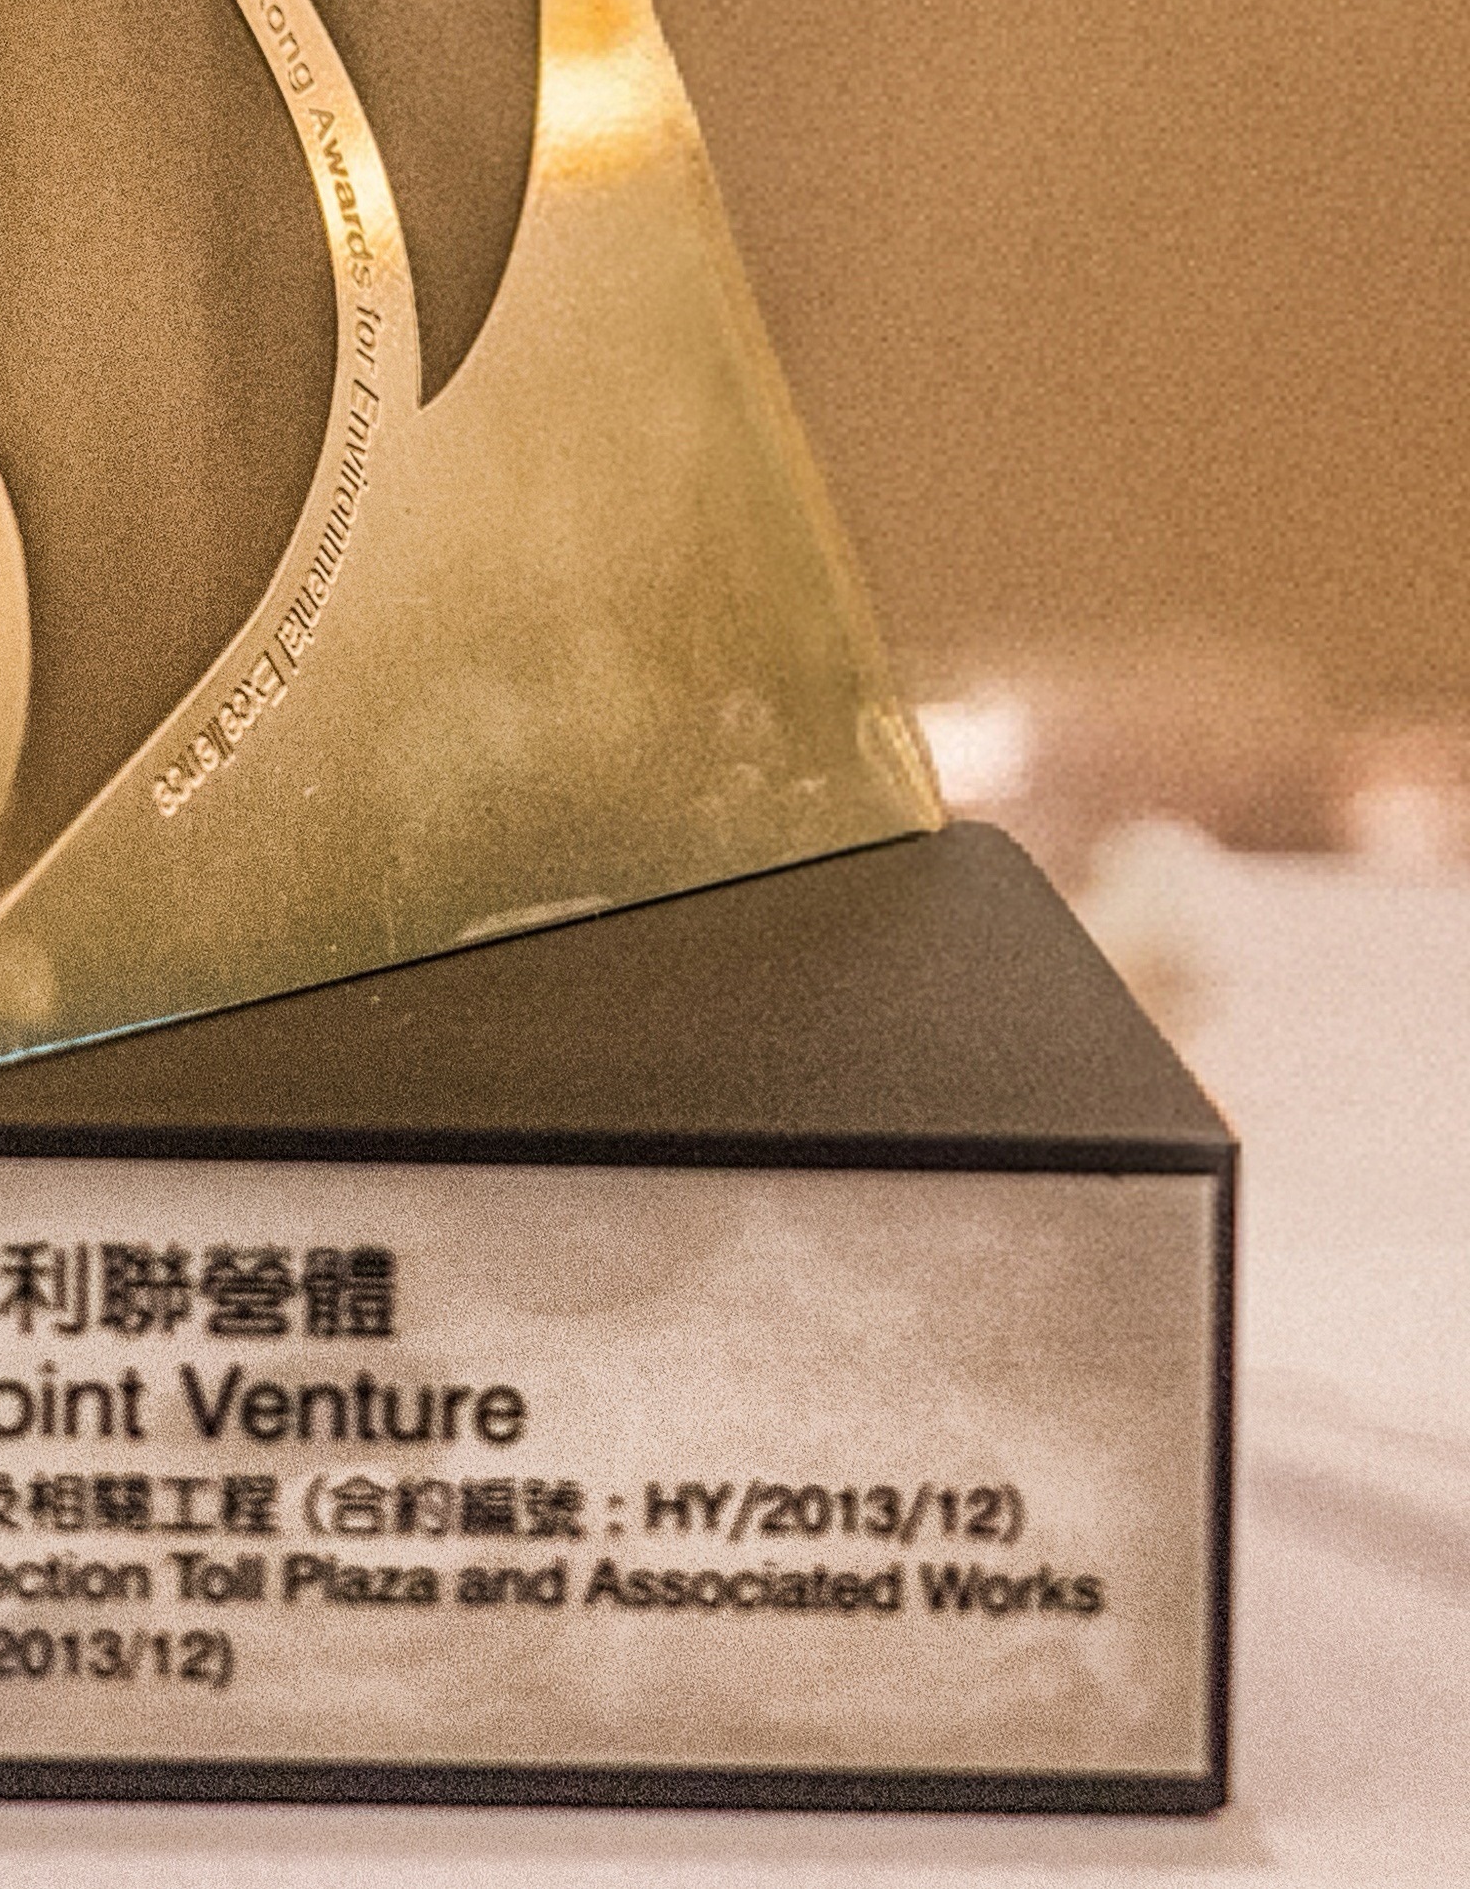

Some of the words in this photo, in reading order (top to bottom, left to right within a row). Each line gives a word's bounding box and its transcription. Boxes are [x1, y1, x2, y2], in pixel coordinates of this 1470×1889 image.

[308, 106, 376, 291] Awards
[355, 306, 384, 375] for
[275, 375, 382, 675] Environmental
[181, 1367, 528, 1446] Venture
[172, 1553, 265, 1605] Toll
[282, 1554, 437, 1609] Plaza
[454, 1557, 567, 1610] and
[583, 1559, 903, 1617] Associated
[918, 1561, 1107, 1620] Works
